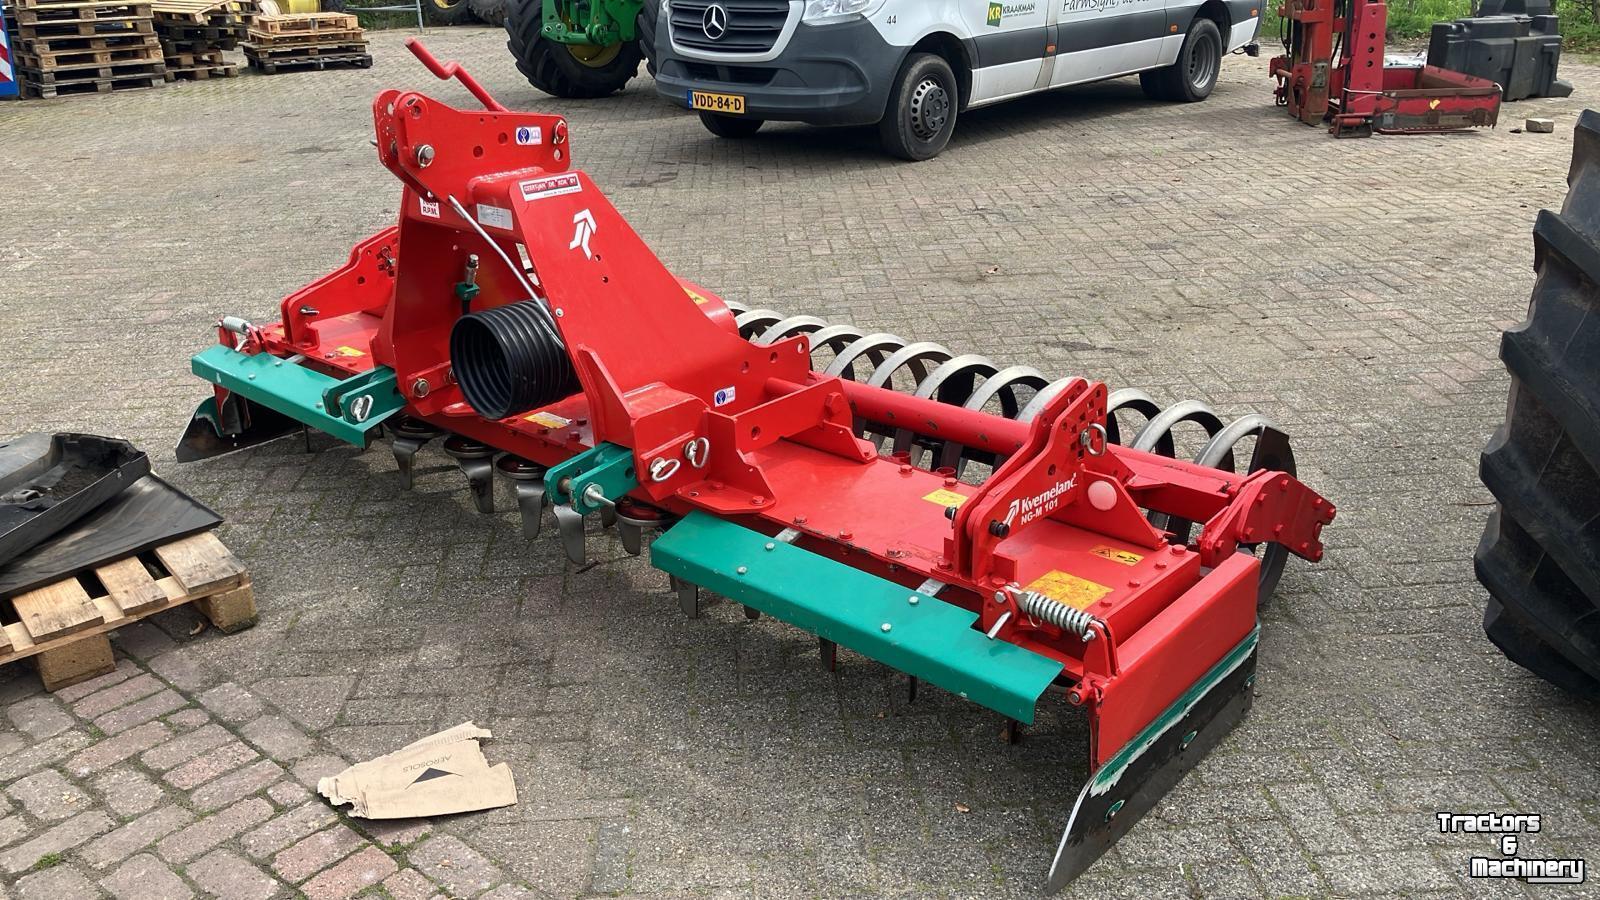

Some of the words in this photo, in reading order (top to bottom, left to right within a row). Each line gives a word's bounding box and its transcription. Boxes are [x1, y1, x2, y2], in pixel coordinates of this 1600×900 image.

[988, 6, 1001, 20] KR
[1002, 3, 1035, 14] KRAAKMAN
[886, 15, 897, 24] 44
[693, 93, 742, 111] VDD-84-D
[1021, 472, 1078, 514] Kverneland
[1021, 506, 1043, 526] NG-M
[1044, 498, 1059, 513] 101
[402, 753, 452, 773] AEROSOLS
